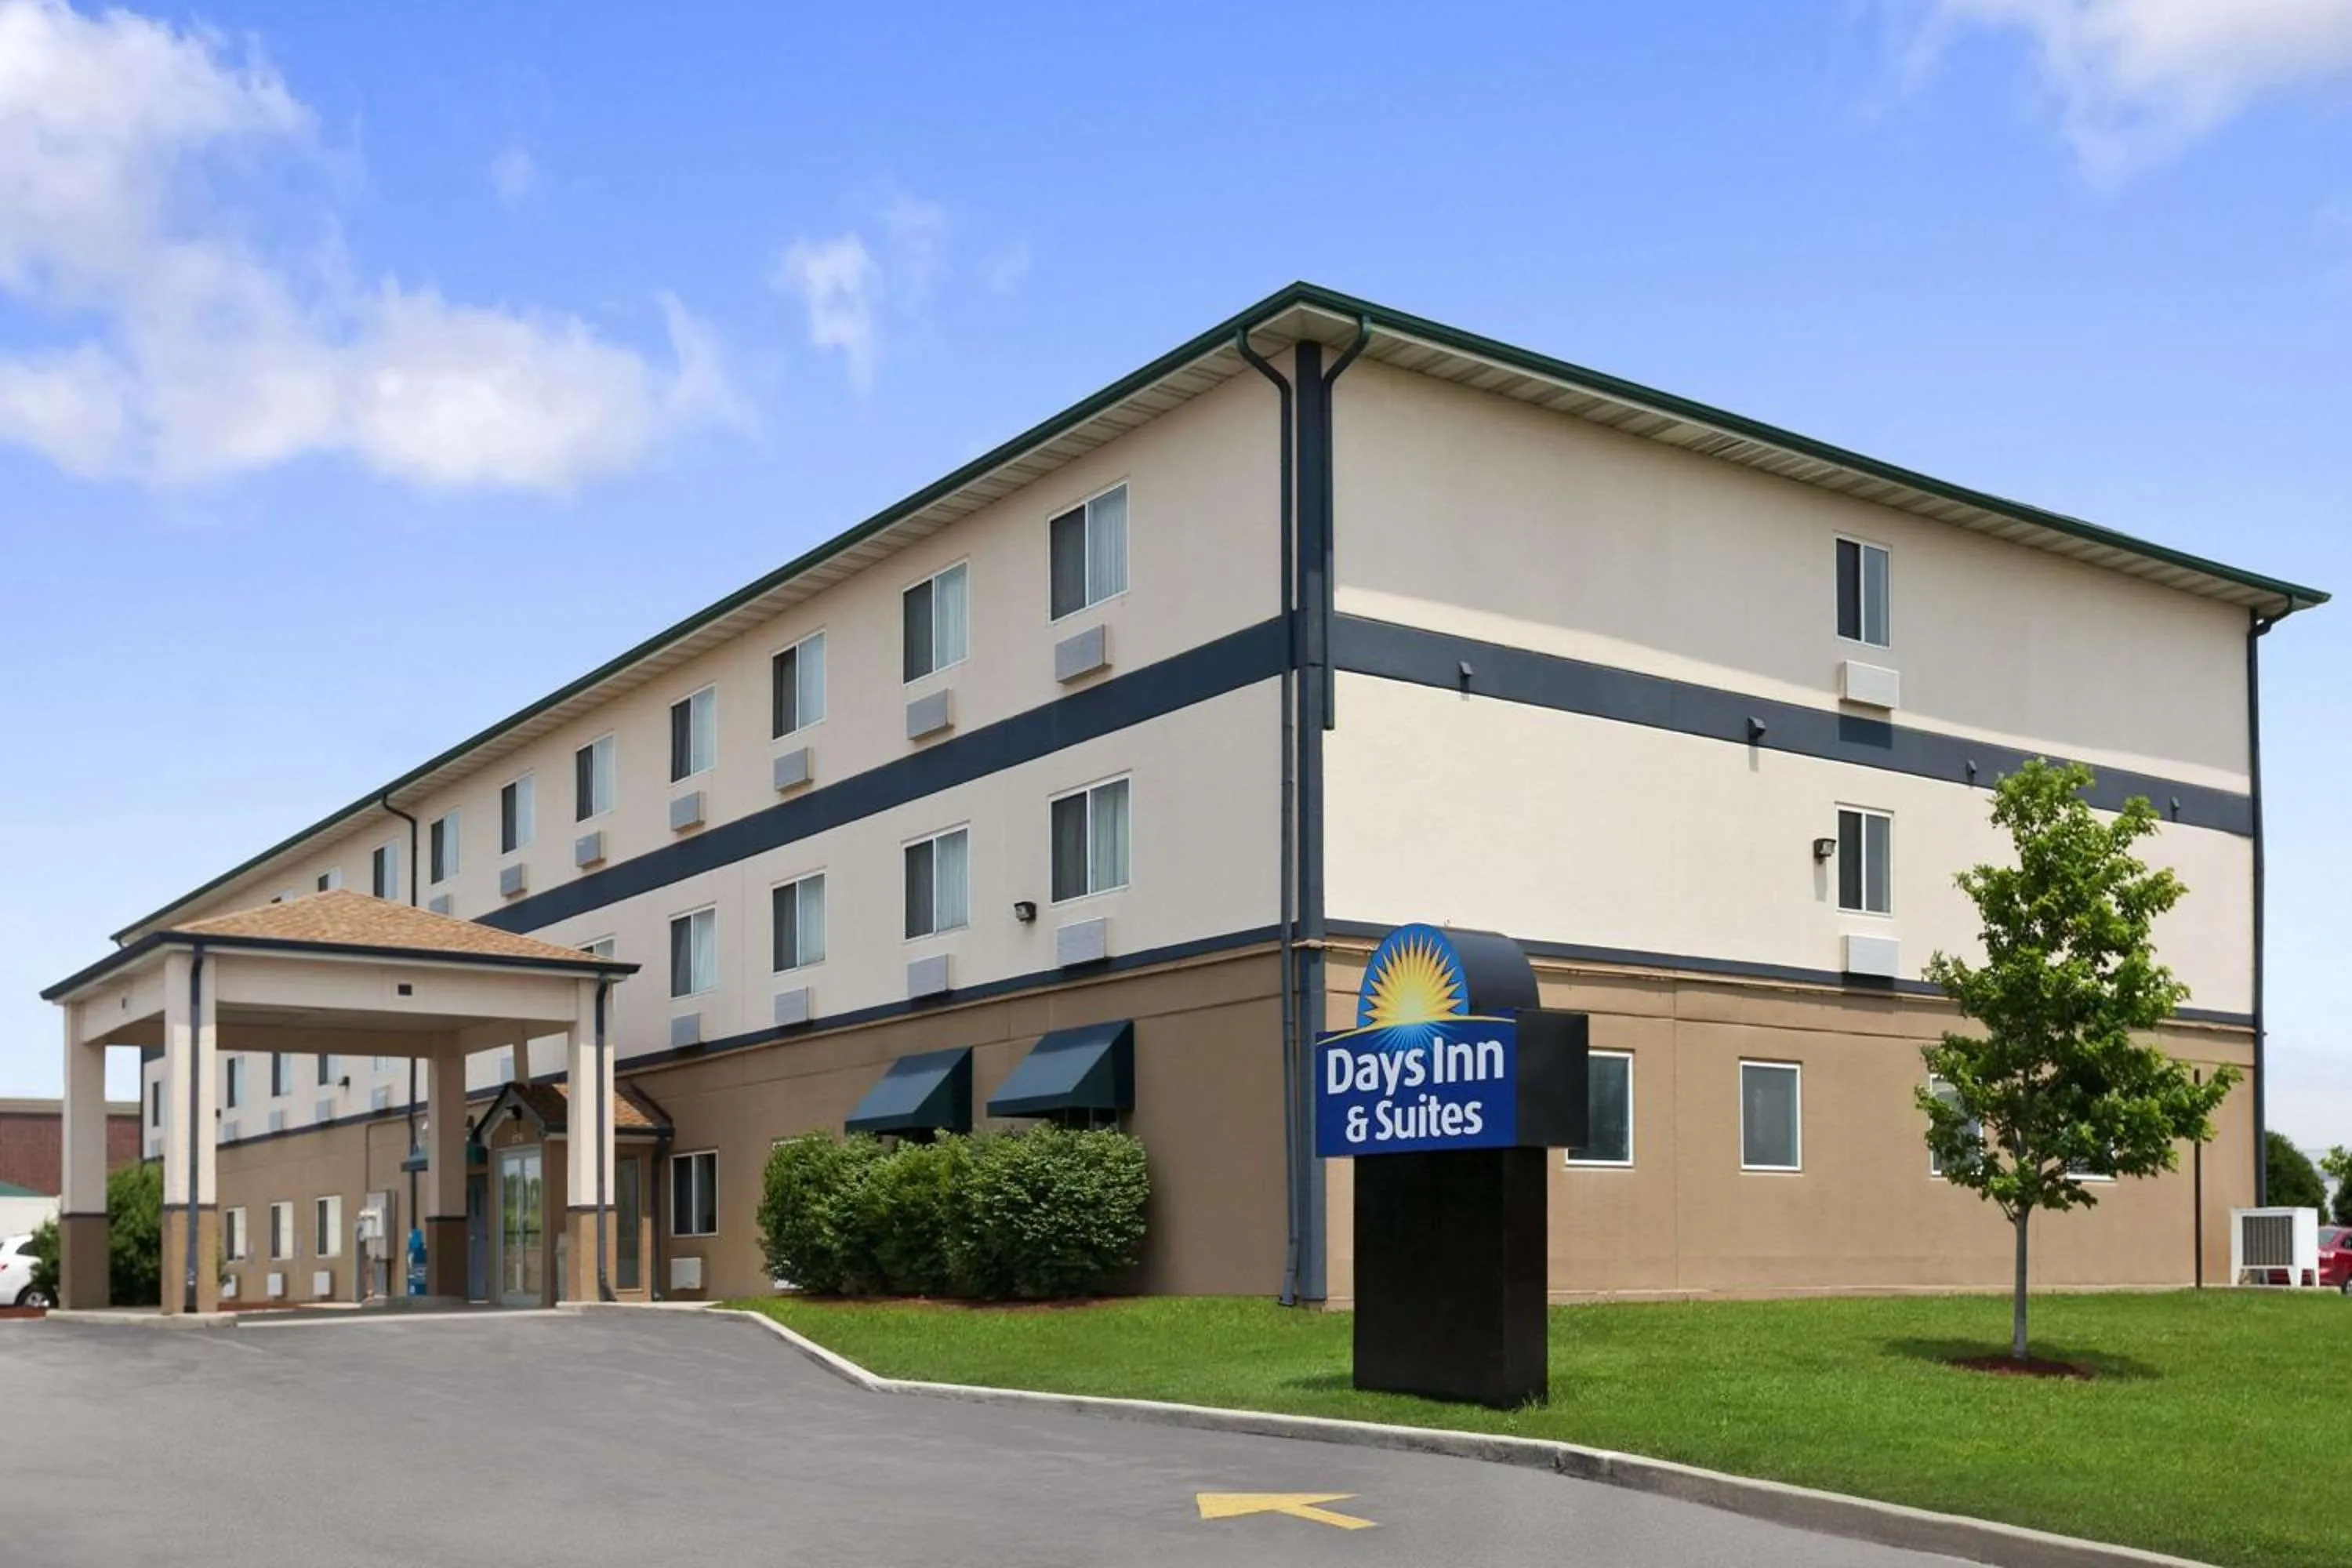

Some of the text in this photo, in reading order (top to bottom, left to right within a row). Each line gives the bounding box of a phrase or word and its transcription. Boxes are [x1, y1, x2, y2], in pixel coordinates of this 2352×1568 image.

[1327, 1036, 1504, 1096] Days Inn
[1345, 1094, 1483, 1144] & Suites
